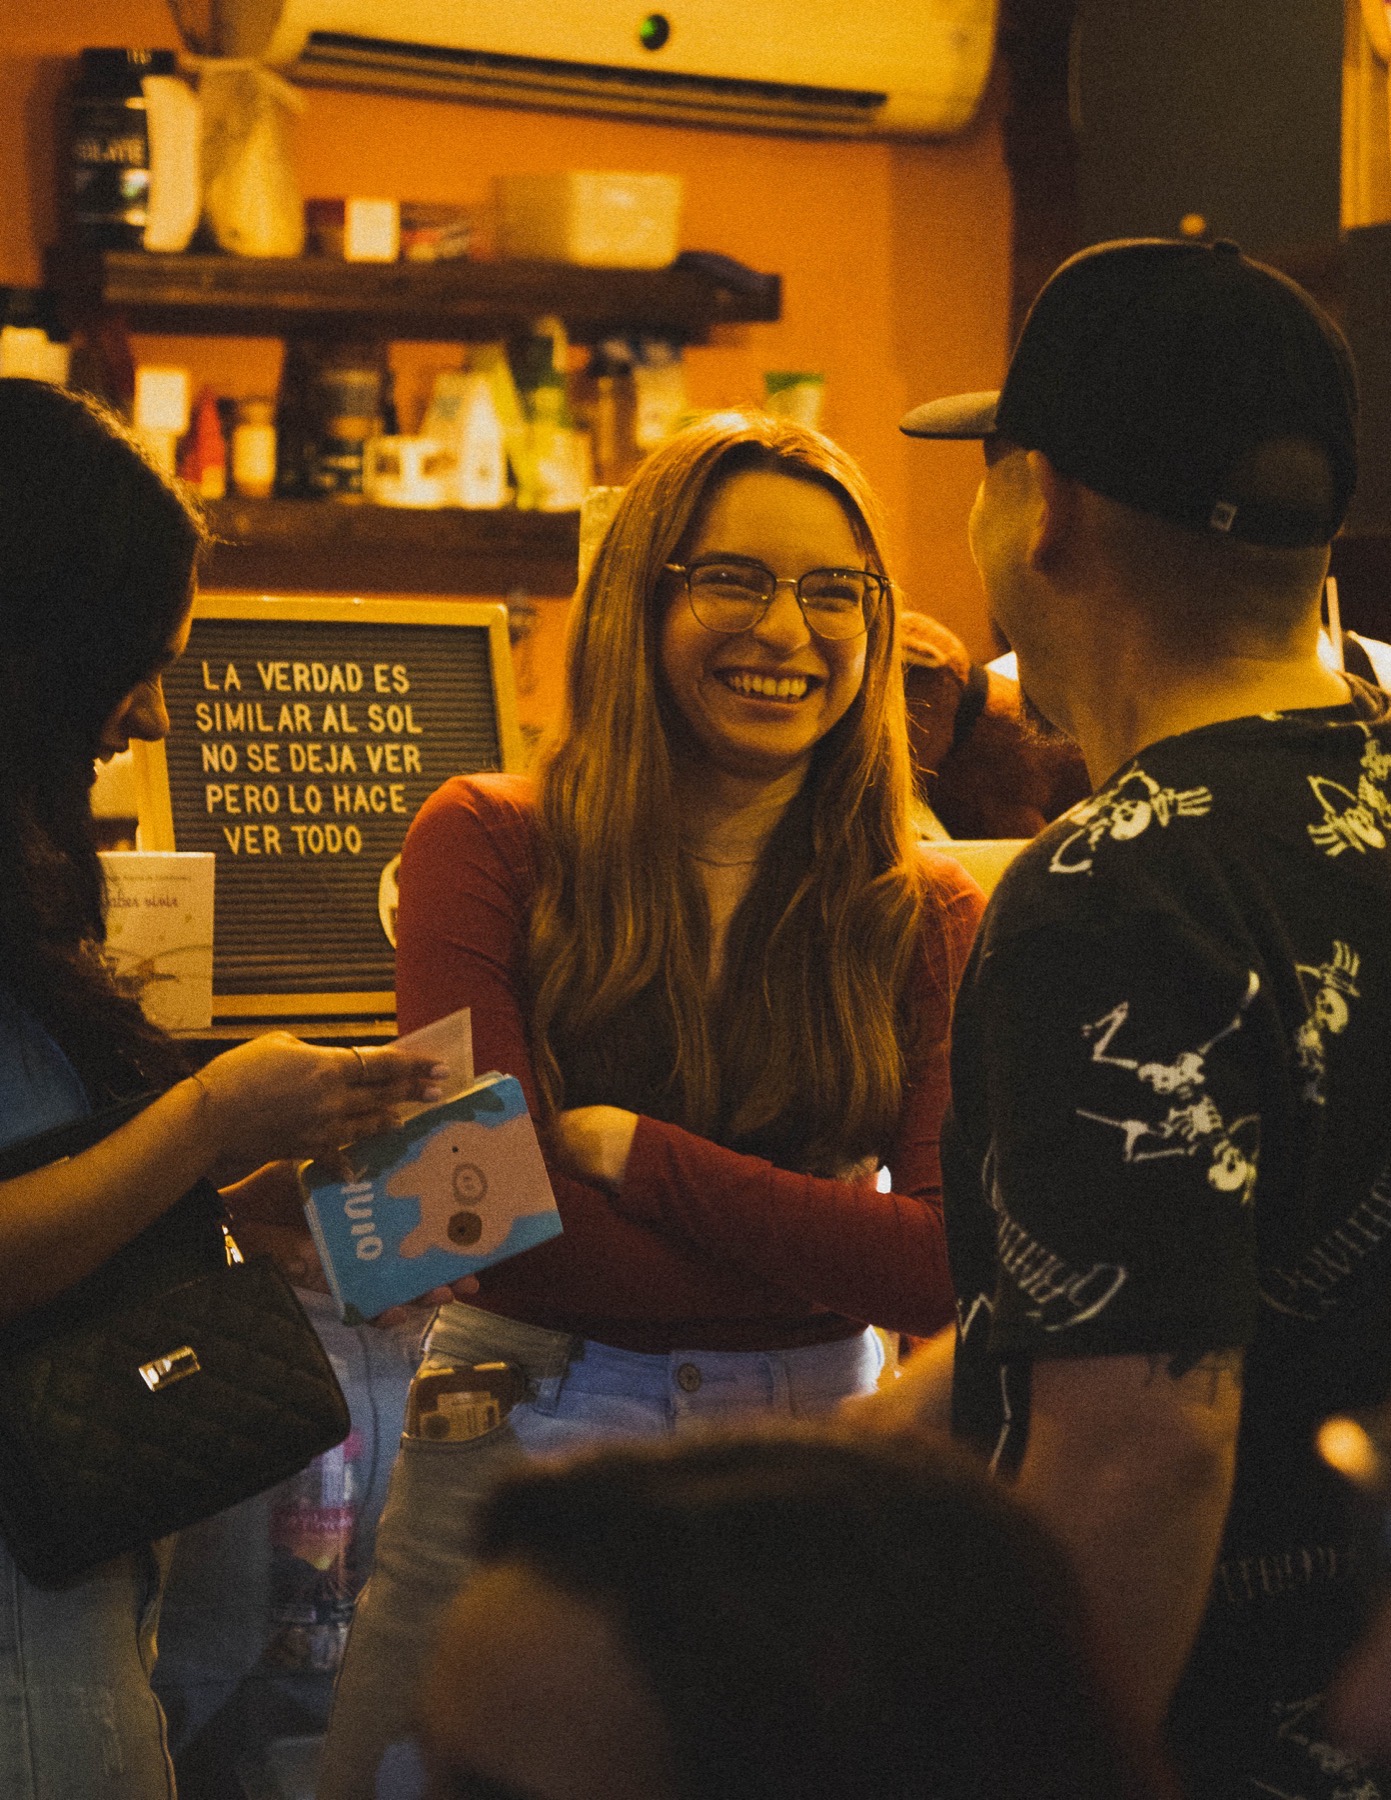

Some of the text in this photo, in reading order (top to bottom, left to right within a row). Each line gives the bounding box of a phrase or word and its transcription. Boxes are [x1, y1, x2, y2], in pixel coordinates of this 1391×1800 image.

[202, 661, 411, 695] LA VERDAD ES
[196, 702, 423, 734] SIMILAR AL SOL
[202, 742, 422, 774] NO SE DEJA VER
[206, 783, 408, 814] PERO LO HACE
[224, 823, 363, 855] VER TODO
